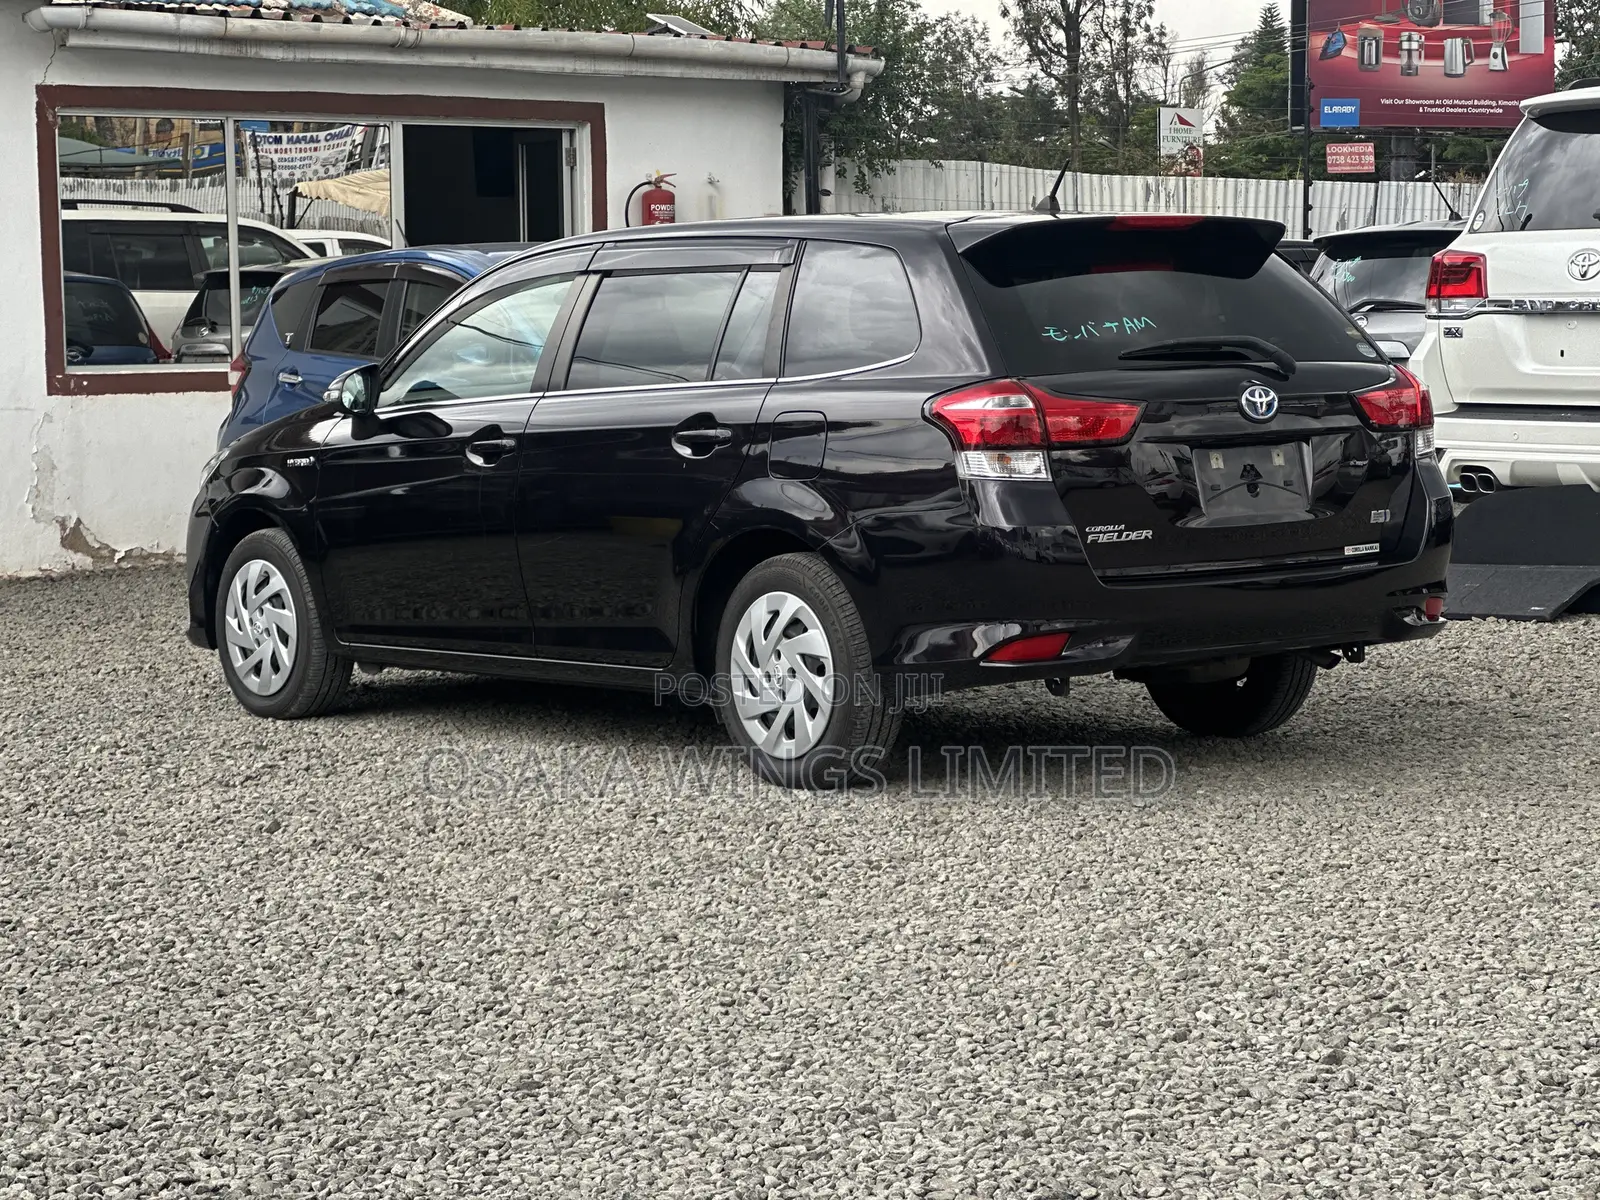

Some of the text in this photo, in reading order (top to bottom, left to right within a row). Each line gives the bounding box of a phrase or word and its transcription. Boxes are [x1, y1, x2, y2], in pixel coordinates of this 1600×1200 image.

[1162, 136, 1202, 144] FURNITURE
[1361, 155, 1374, 163] 399
[1085, 524, 1125, 532] COROLLA
[1087, 530, 1153, 543] FIELDER
